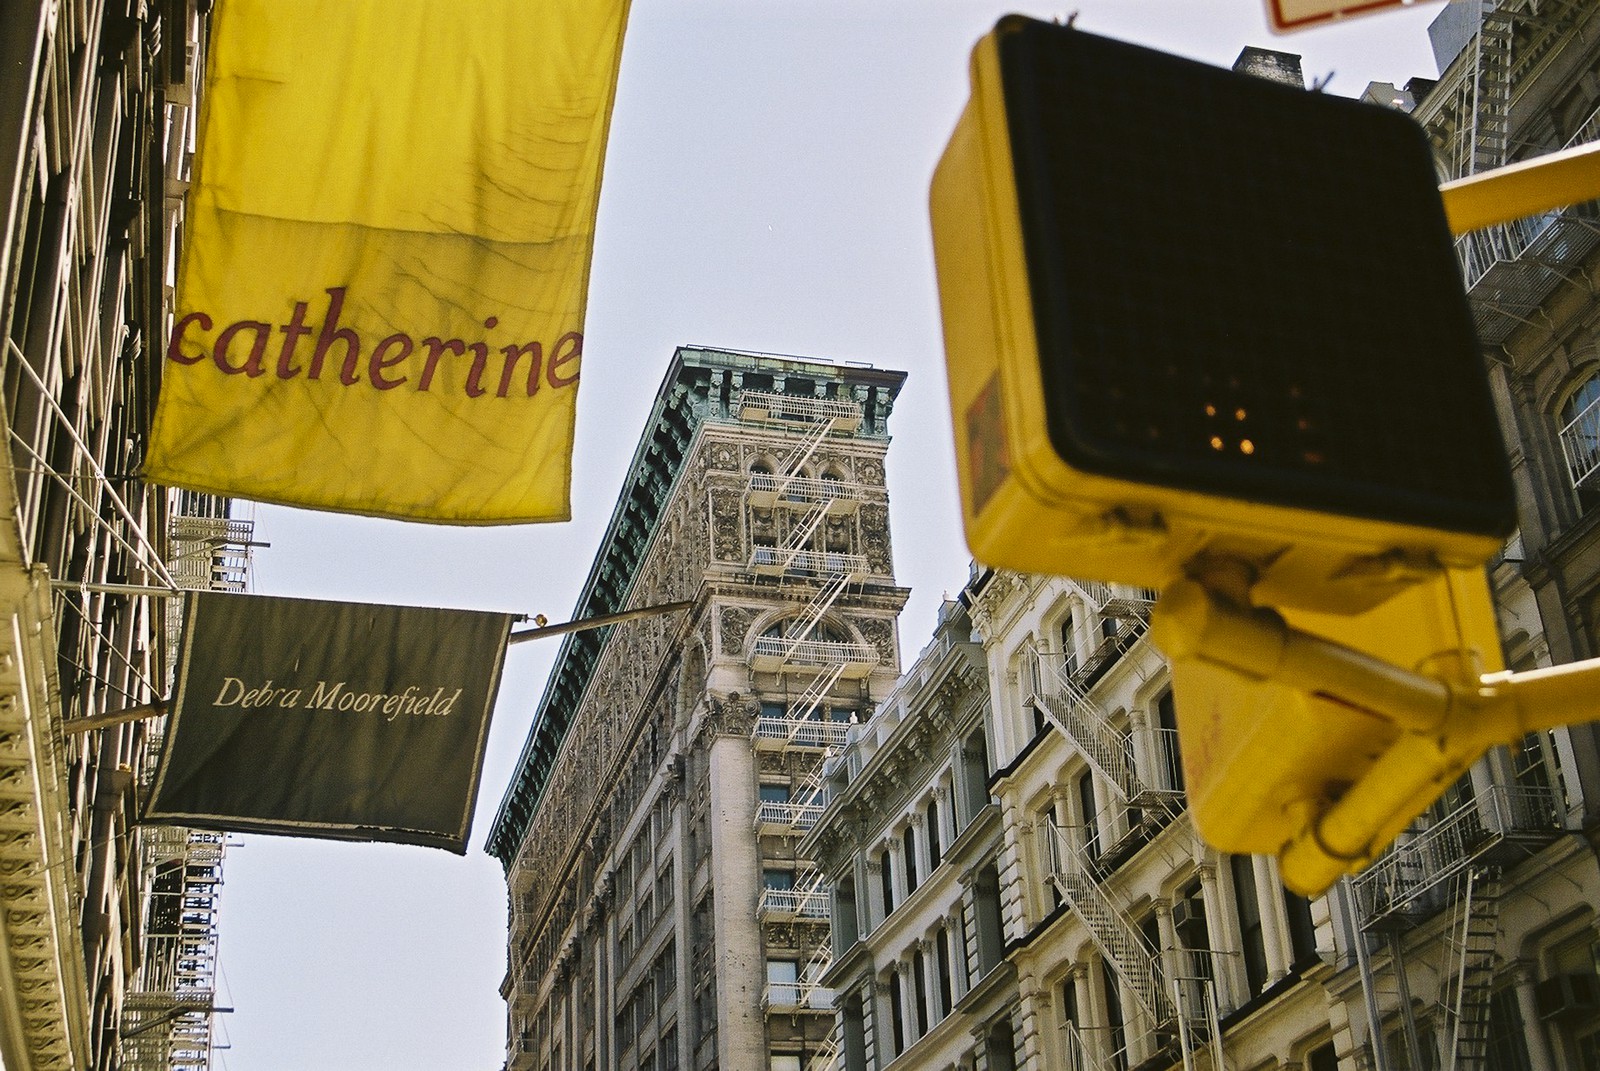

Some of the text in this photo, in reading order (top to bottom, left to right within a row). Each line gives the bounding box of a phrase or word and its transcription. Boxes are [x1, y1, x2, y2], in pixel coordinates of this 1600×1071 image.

[167, 287, 584, 398] catherine
[212, 677, 463, 721] Debra Moorefield
